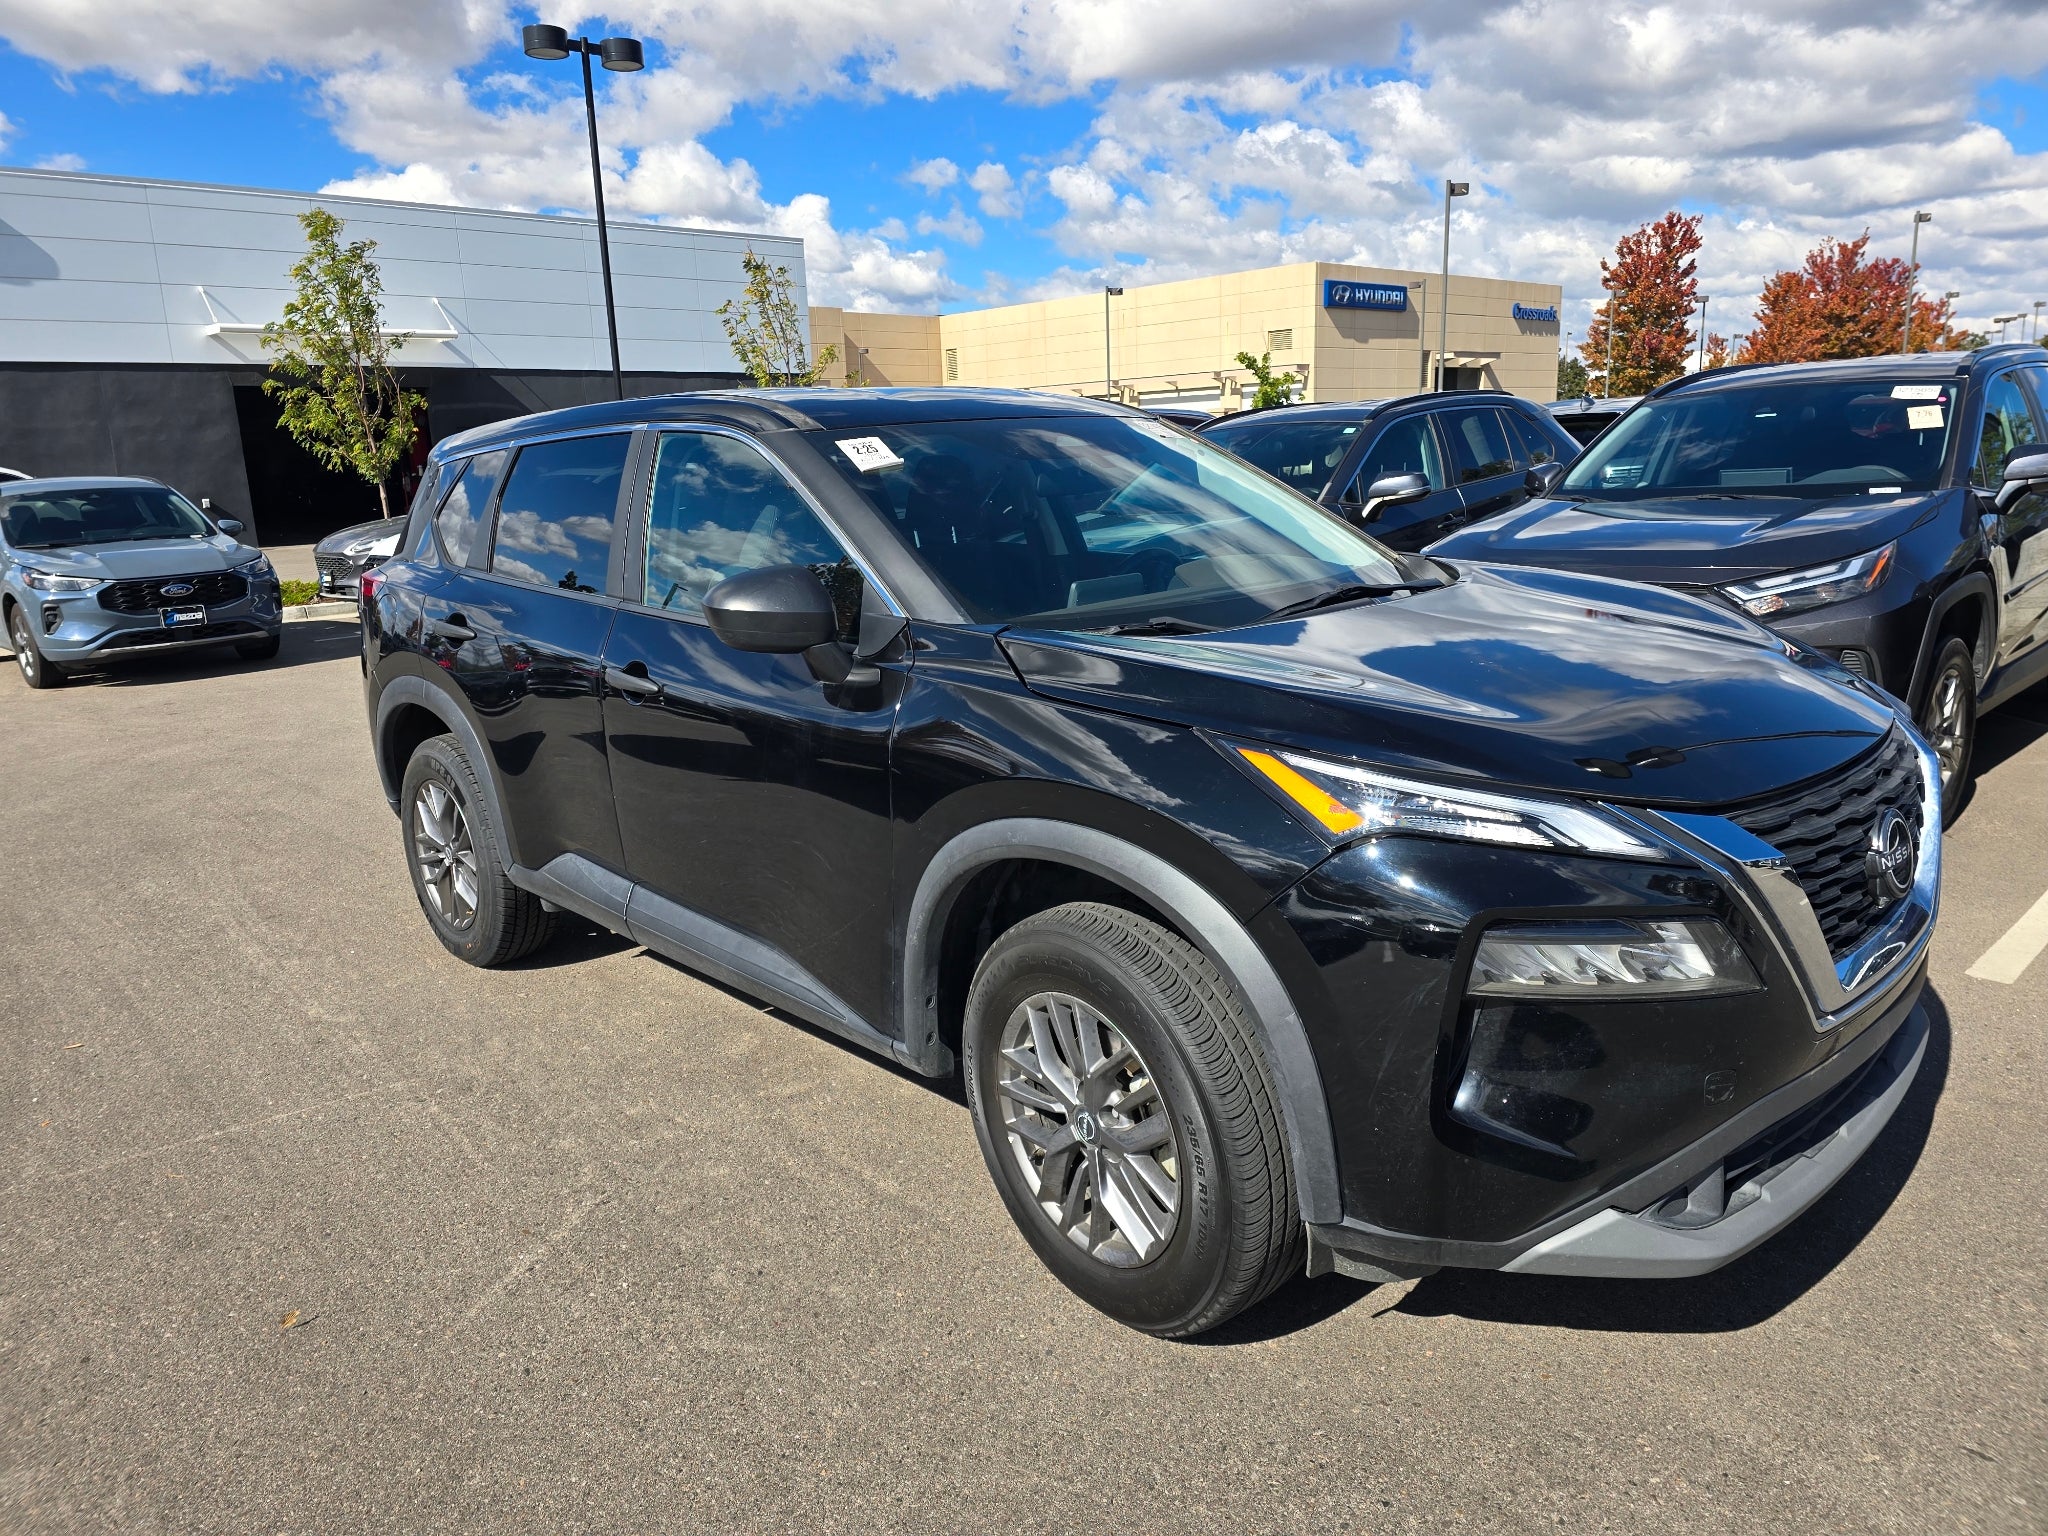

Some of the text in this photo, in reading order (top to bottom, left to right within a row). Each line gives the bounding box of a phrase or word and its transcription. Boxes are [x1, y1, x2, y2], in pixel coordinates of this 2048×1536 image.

[1355, 288, 1404, 306] HYUNDAI
[1512, 302, 1558, 322] Crossroads
[1881, 843, 1910, 869] NISS
[1183, 1114, 1207, 1178] 235/65
[1197, 1181, 1209, 1218] R17
